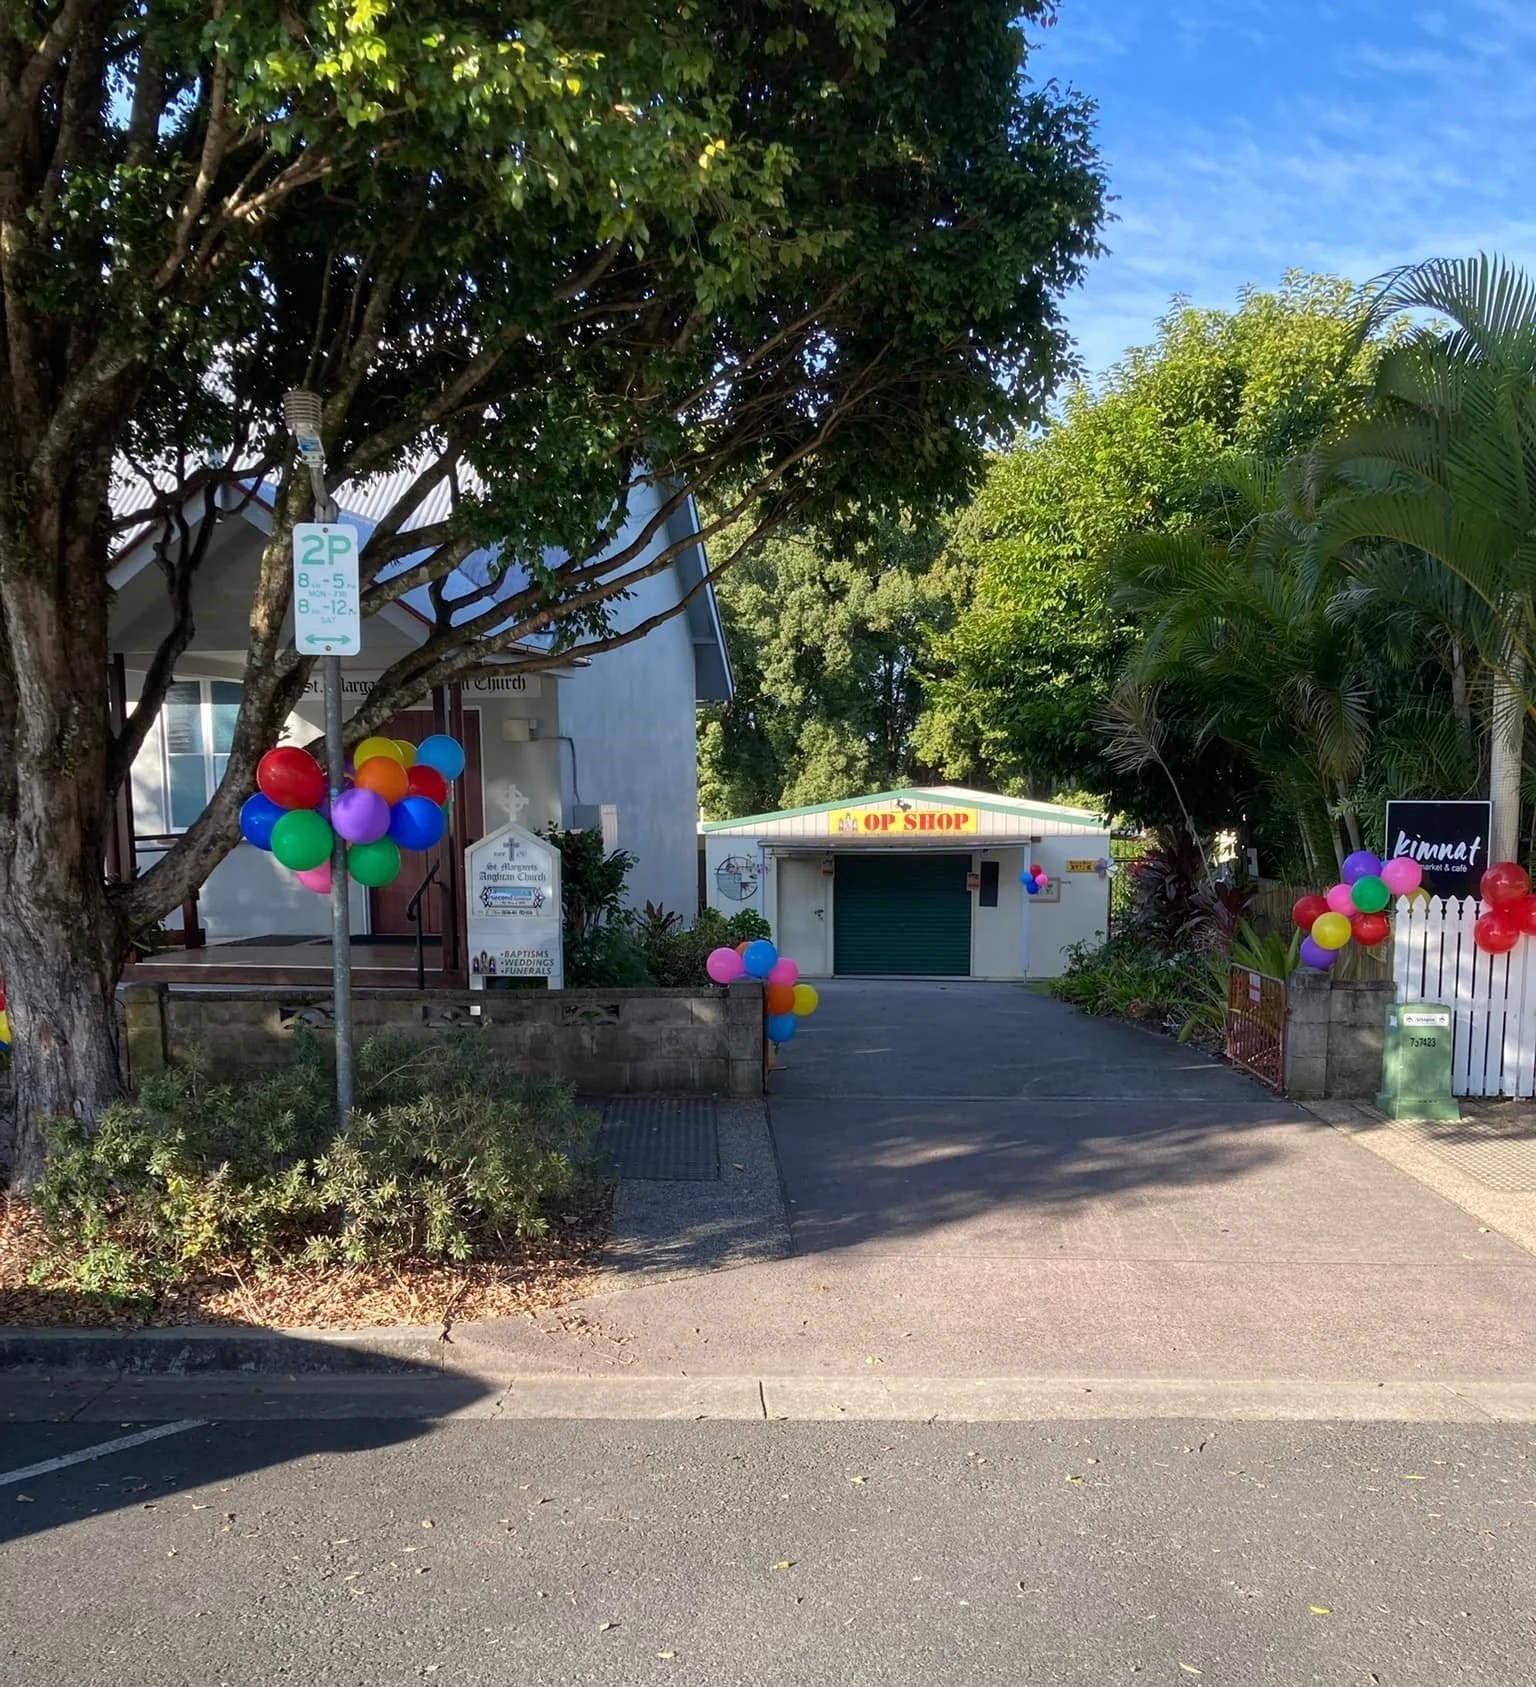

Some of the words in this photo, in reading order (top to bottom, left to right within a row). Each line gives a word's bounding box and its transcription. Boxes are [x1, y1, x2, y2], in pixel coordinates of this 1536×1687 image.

[301, 534, 352, 566] 2P
[474, 675, 526, 693] Church
[864, 813, 896, 831] OP
[903, 812, 969, 831] SHOP
[1393, 830, 1481, 866] kimnat
[516, 872, 546, 883] Church
